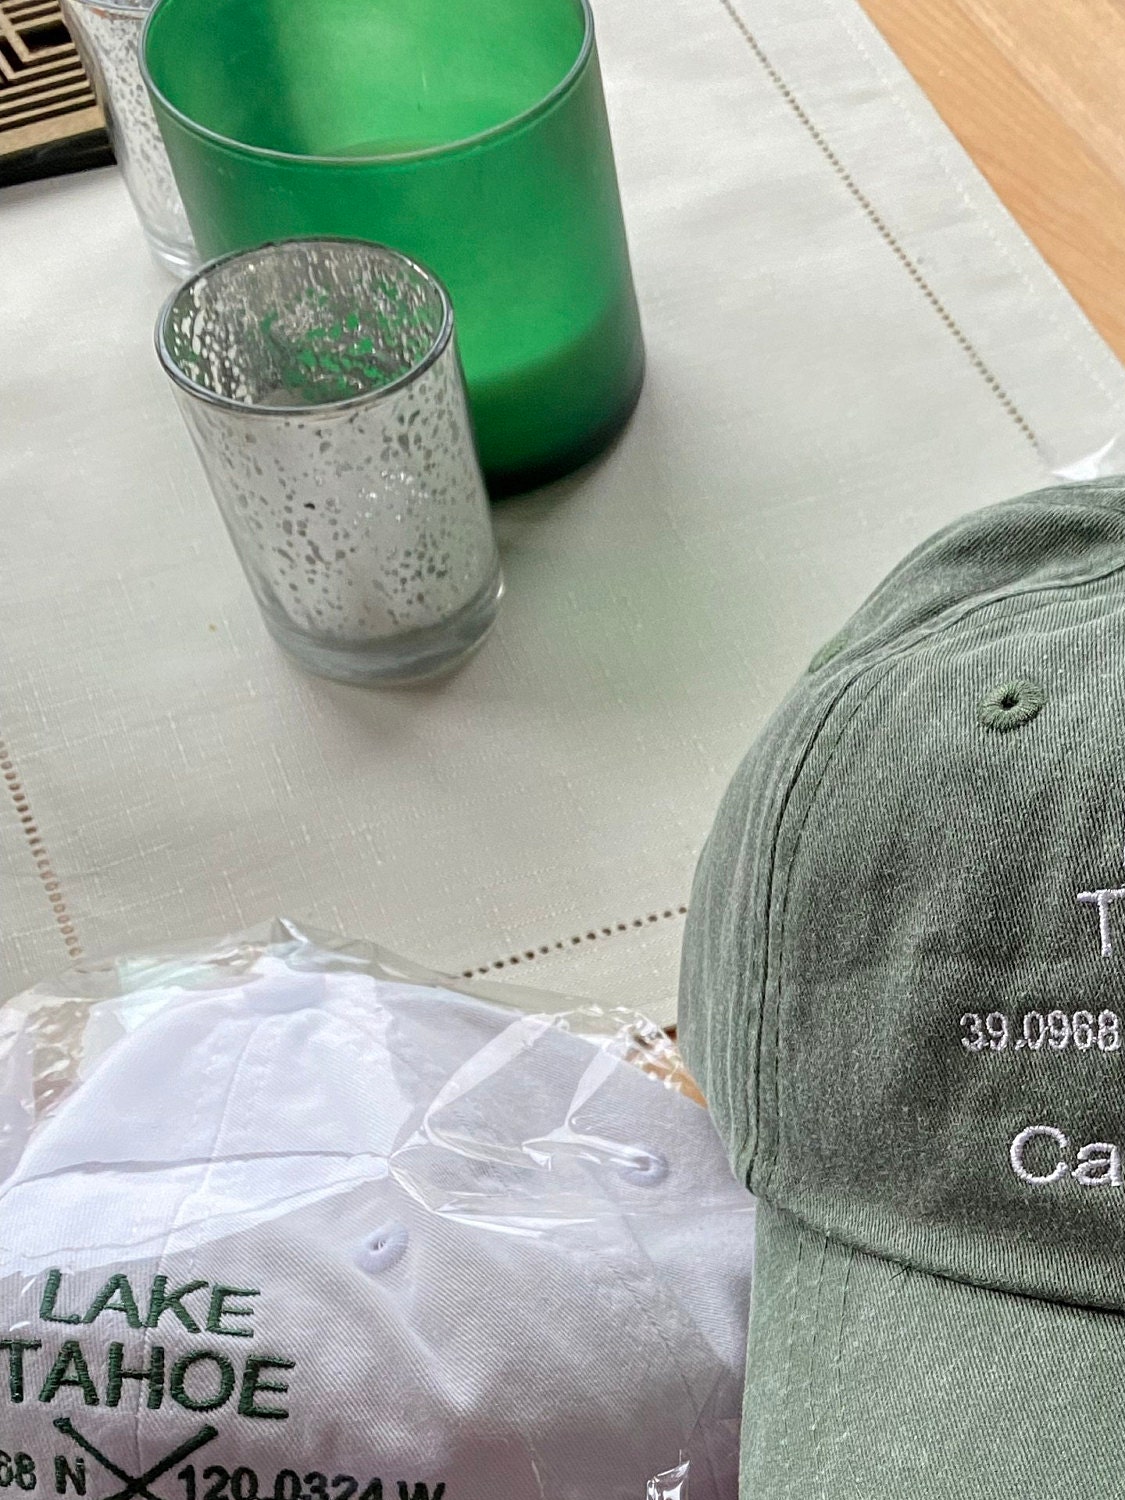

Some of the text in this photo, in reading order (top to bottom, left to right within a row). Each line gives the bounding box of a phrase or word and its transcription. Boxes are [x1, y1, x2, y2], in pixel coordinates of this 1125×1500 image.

[960, 1009, 1122, 1054] 39.0968
[39, 1269, 261, 1338] LAKE
[0, 1338, 296, 1419] TAHOE
[54, 1455, 87, 1496] N
